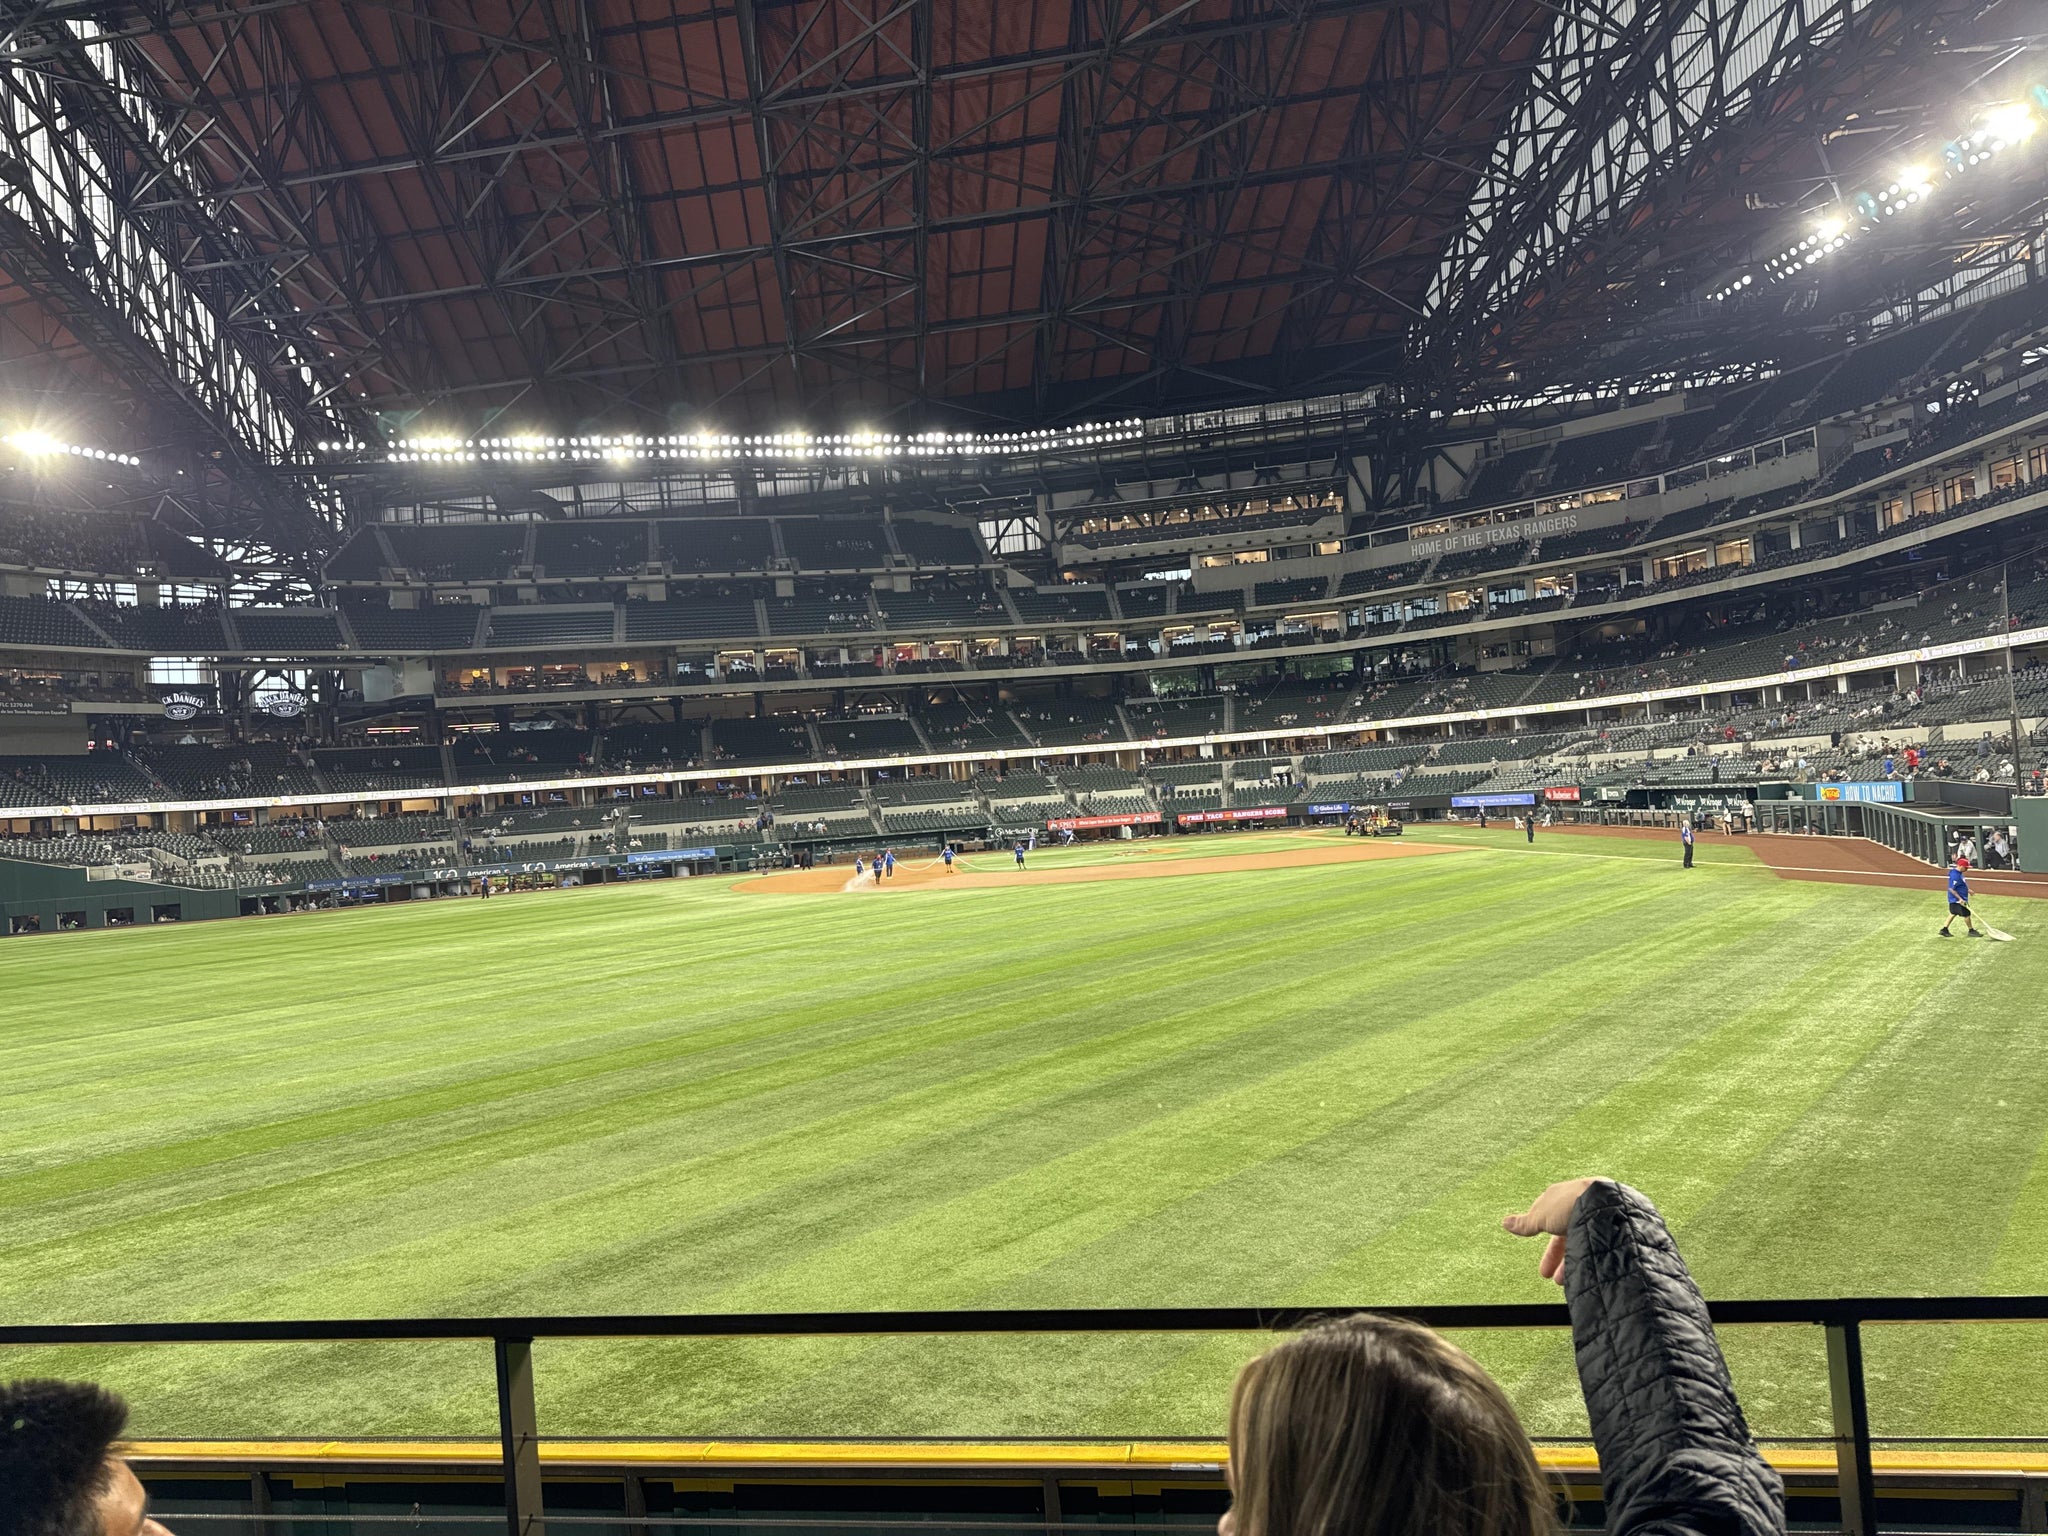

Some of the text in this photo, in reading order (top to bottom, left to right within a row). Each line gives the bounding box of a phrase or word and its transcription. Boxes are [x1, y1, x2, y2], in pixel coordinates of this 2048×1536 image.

[1411, 514, 1578, 557] HOME OF THE TEXAS RANGERS
[162, 696, 173, 705] CK
[1844, 785, 1898, 801] HOW TO NACHO!
[1187, 814, 1204, 822] FREE
[1232, 810, 1263, 818] RANGERS
[1264, 808, 1287, 816] SCORE
[554, 861, 588, 870] American
[466, 868, 501, 877] American
